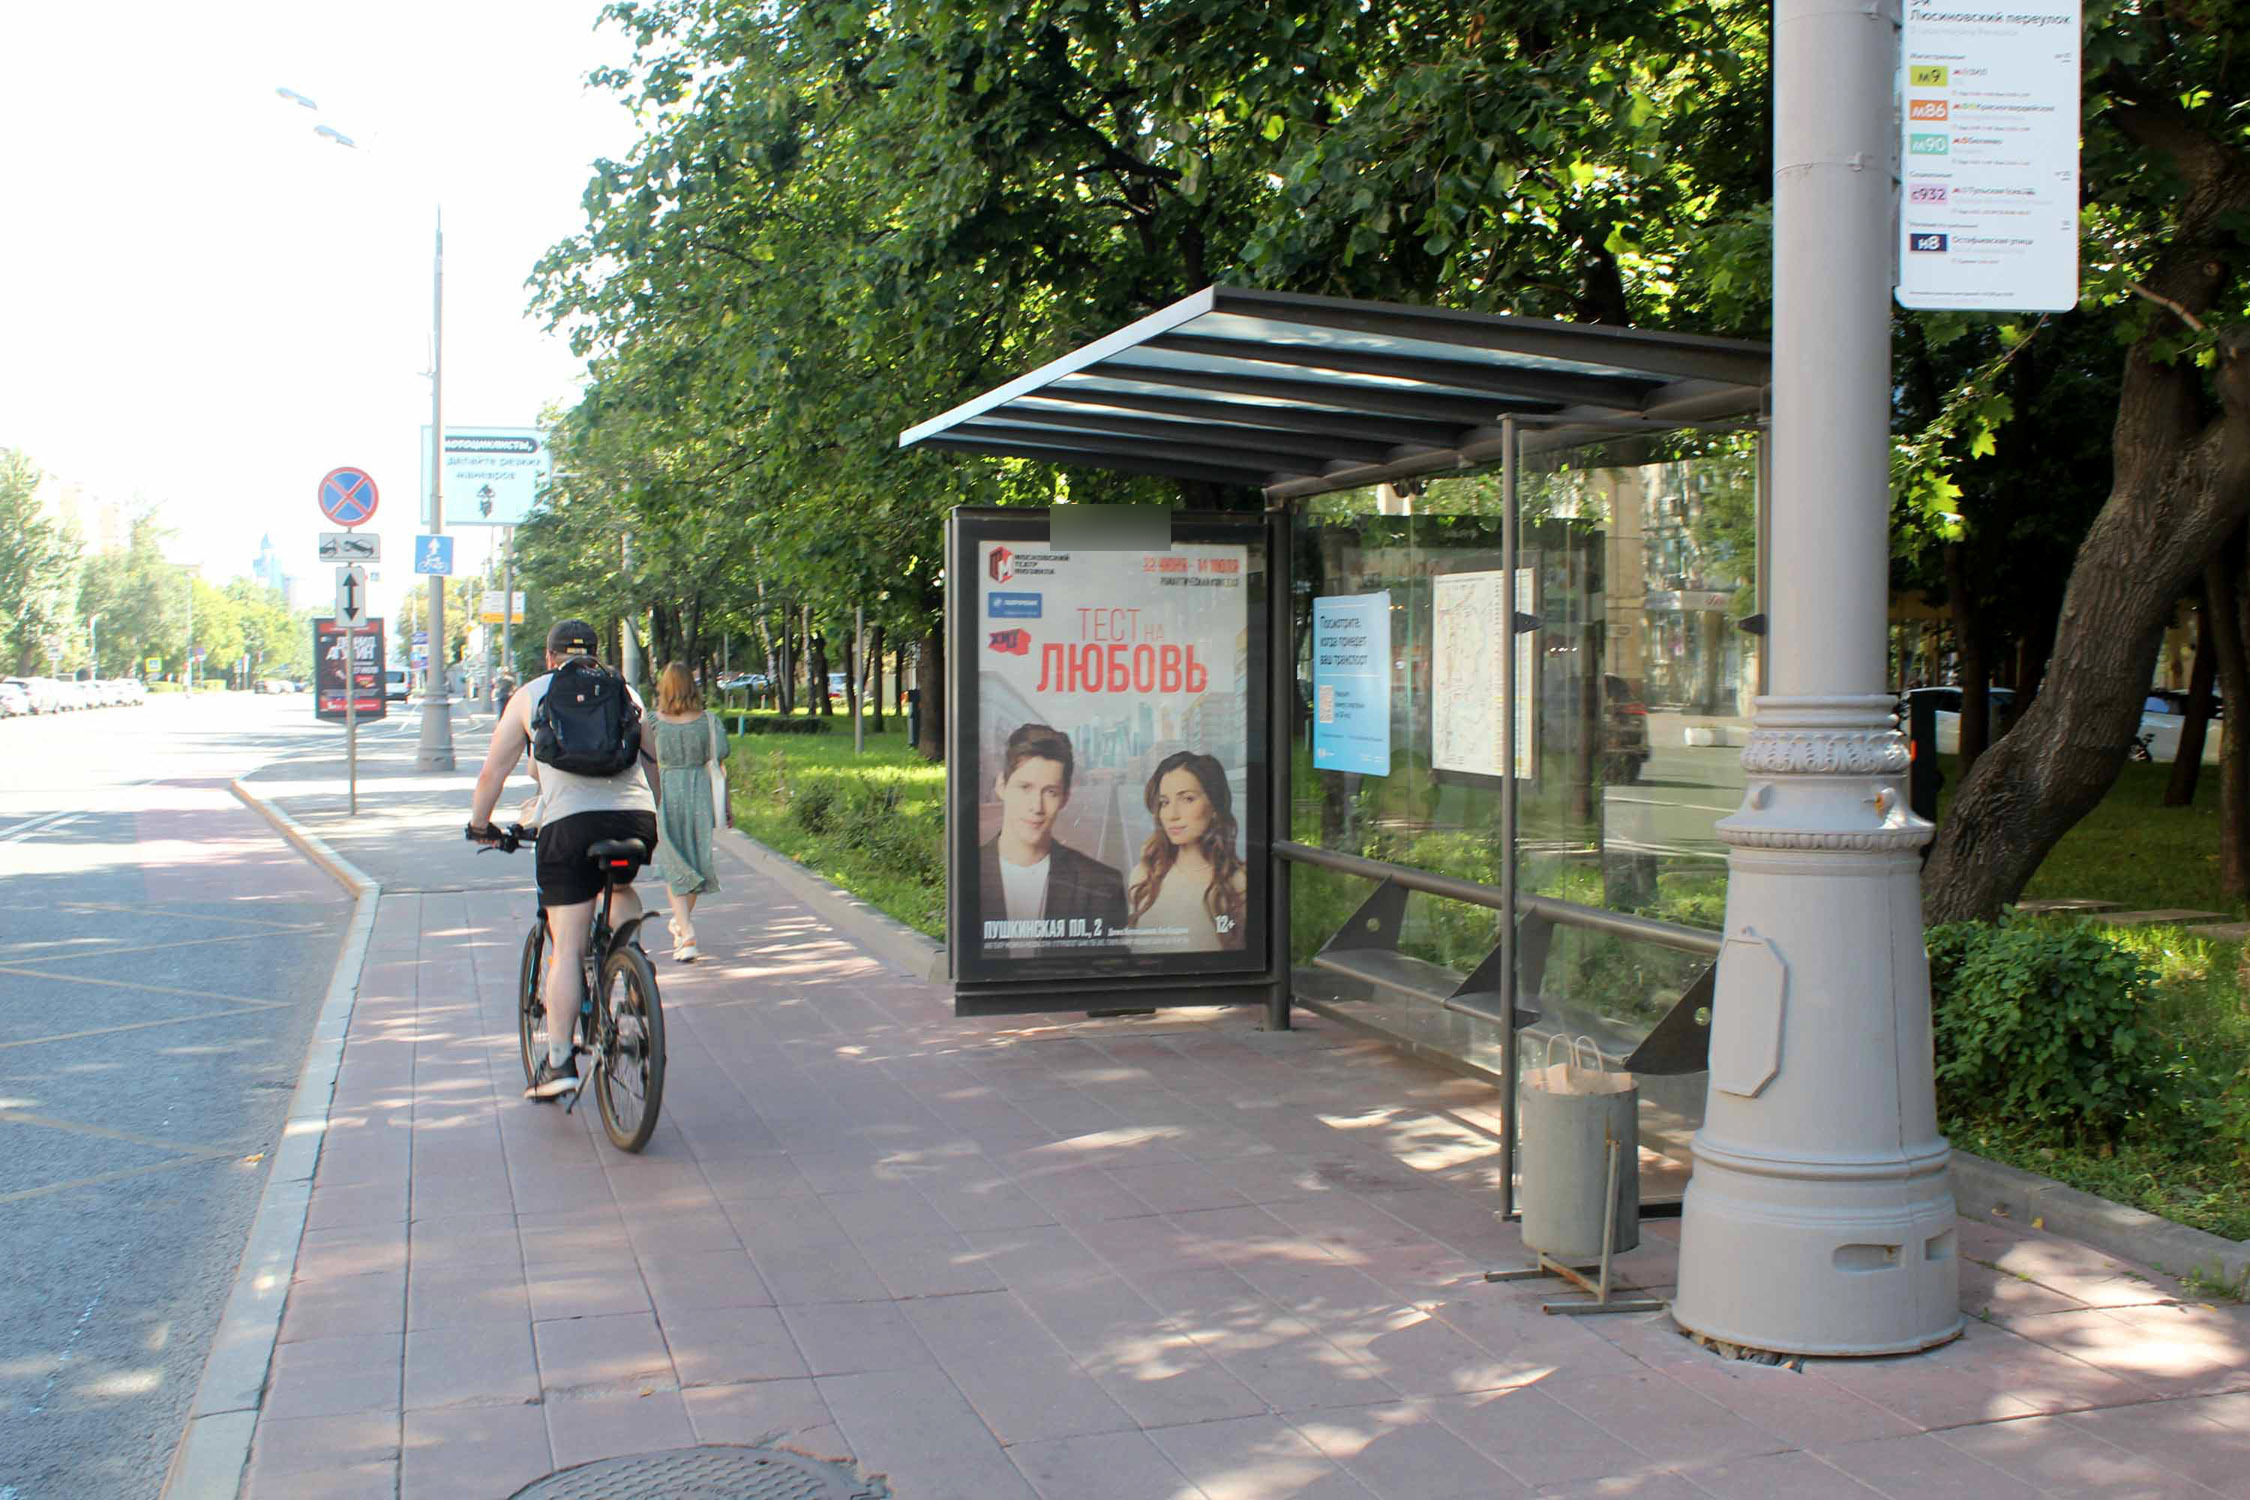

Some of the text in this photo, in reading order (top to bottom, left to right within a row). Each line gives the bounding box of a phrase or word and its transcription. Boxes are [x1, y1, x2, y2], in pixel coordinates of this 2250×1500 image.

[2006, 14, 2071, 27] переулок
[1918, 69, 1941, 83] м9
[1912, 103, 1946, 118] м86
[1912, 137, 1946, 152] м90
[1912, 187, 1946, 201] с932
[1918, 236, 1941, 250] н8
[1077, 608, 1165, 642] ТЕСТ НА
[1037, 643, 1208, 693] ЛЮБОВЬ
[984, 920, 1066, 939] ПУШКИНСКАЯ
[1093, 918, 1103, 937] 2
[1215, 915, 1235, 934] 12+
